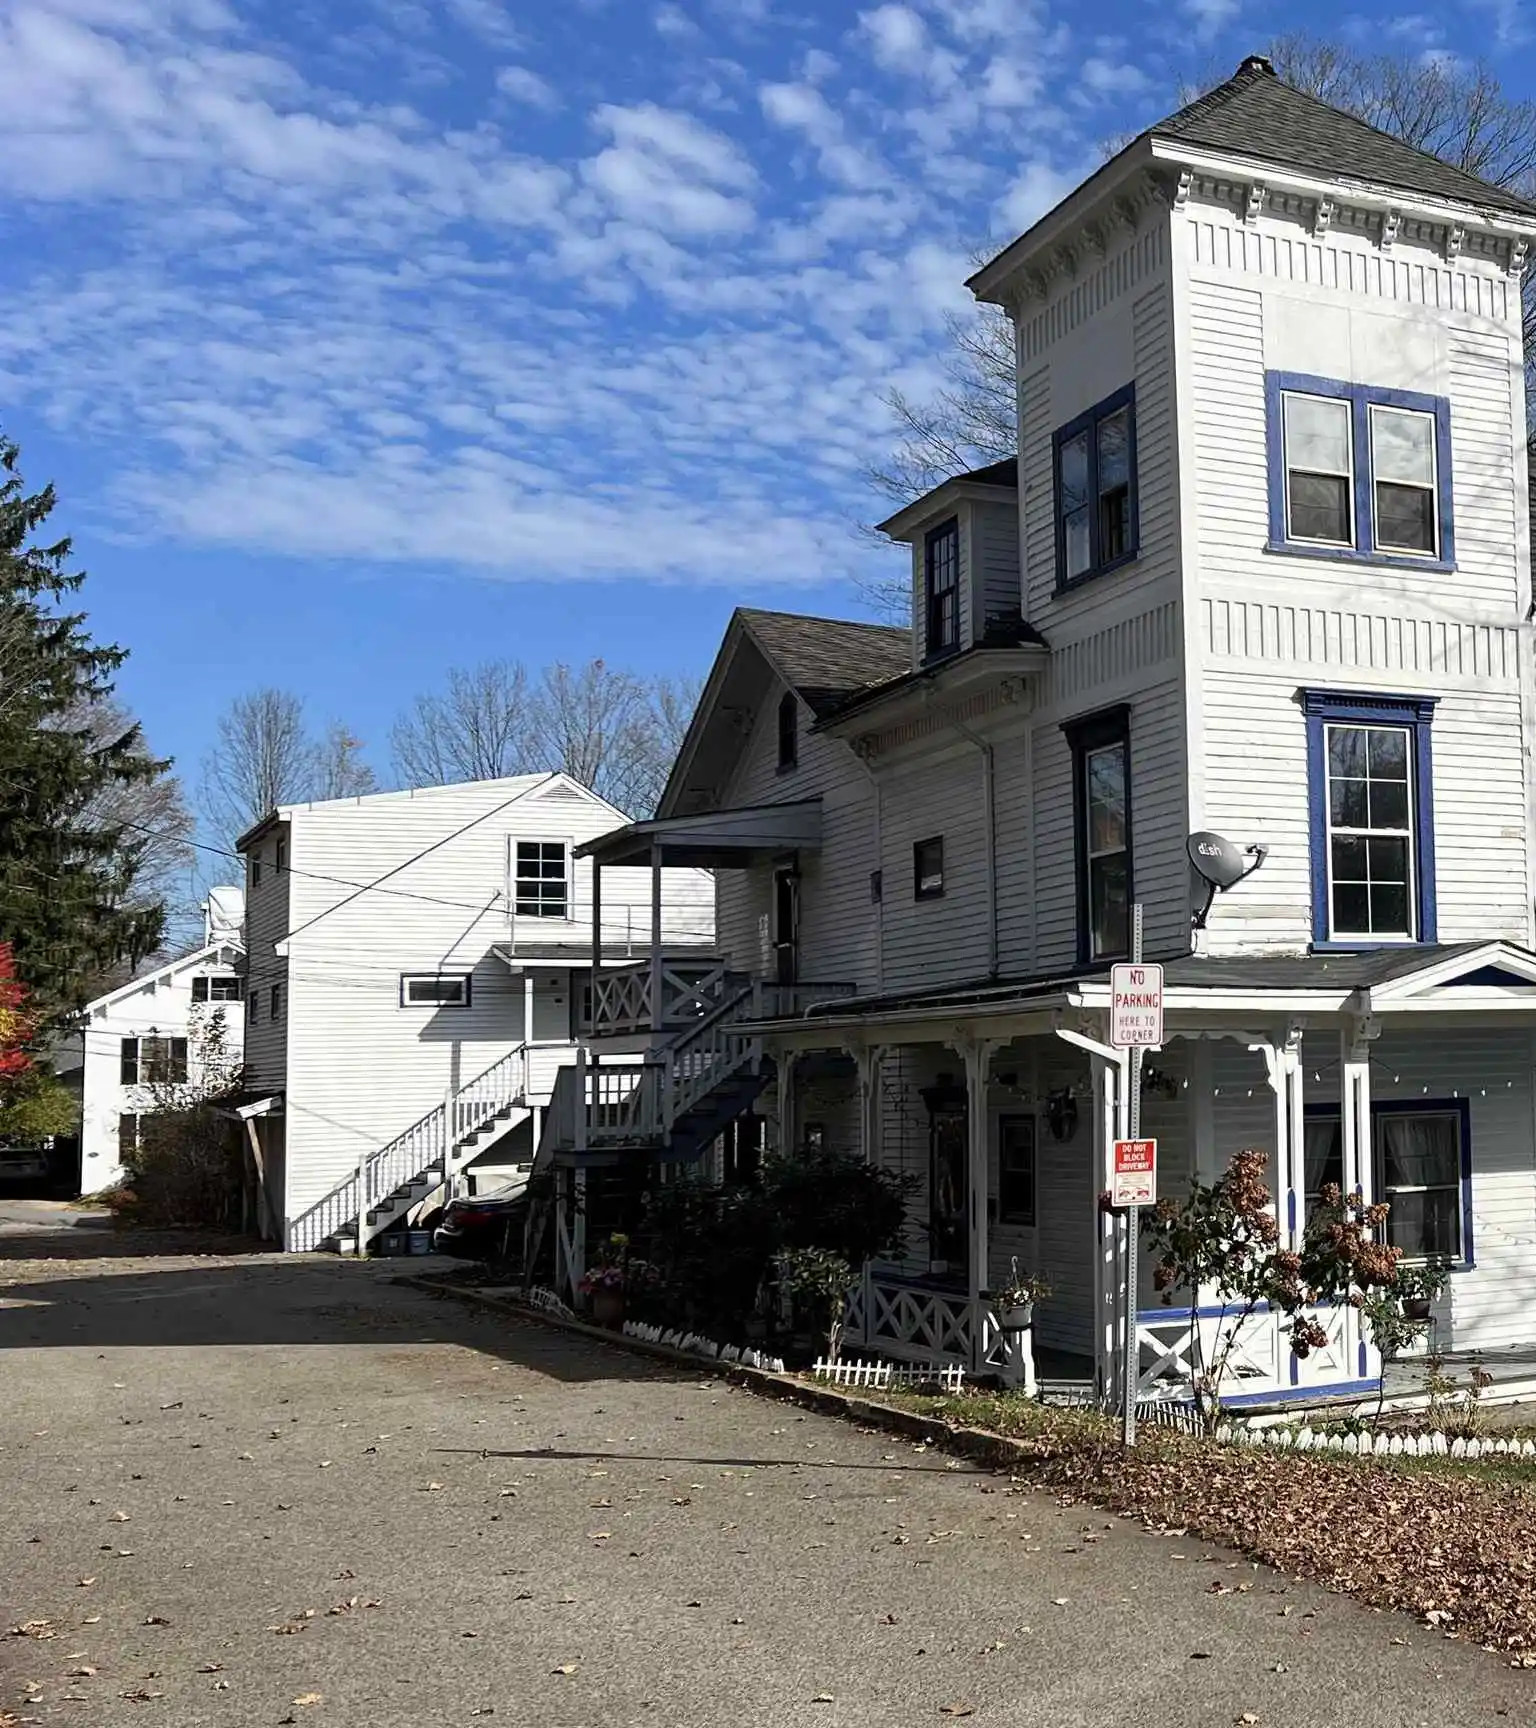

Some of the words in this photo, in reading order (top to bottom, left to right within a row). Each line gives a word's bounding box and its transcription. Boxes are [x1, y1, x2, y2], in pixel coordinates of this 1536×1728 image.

[1198, 841, 1222, 857] dish
[1130, 970, 1145, 985] NO
[1115, 993, 1159, 1009] PARKING
[1119, 1015, 1140, 1027] HERE
[1145, 1015, 1156, 1027] TO
[1120, 1029, 1154, 1041] CORNER
[1122, 1144, 1132, 1152] DO
[1133, 1143, 1147, 1152] NOT
[1123, 1153, 1146, 1161] BLOCK
